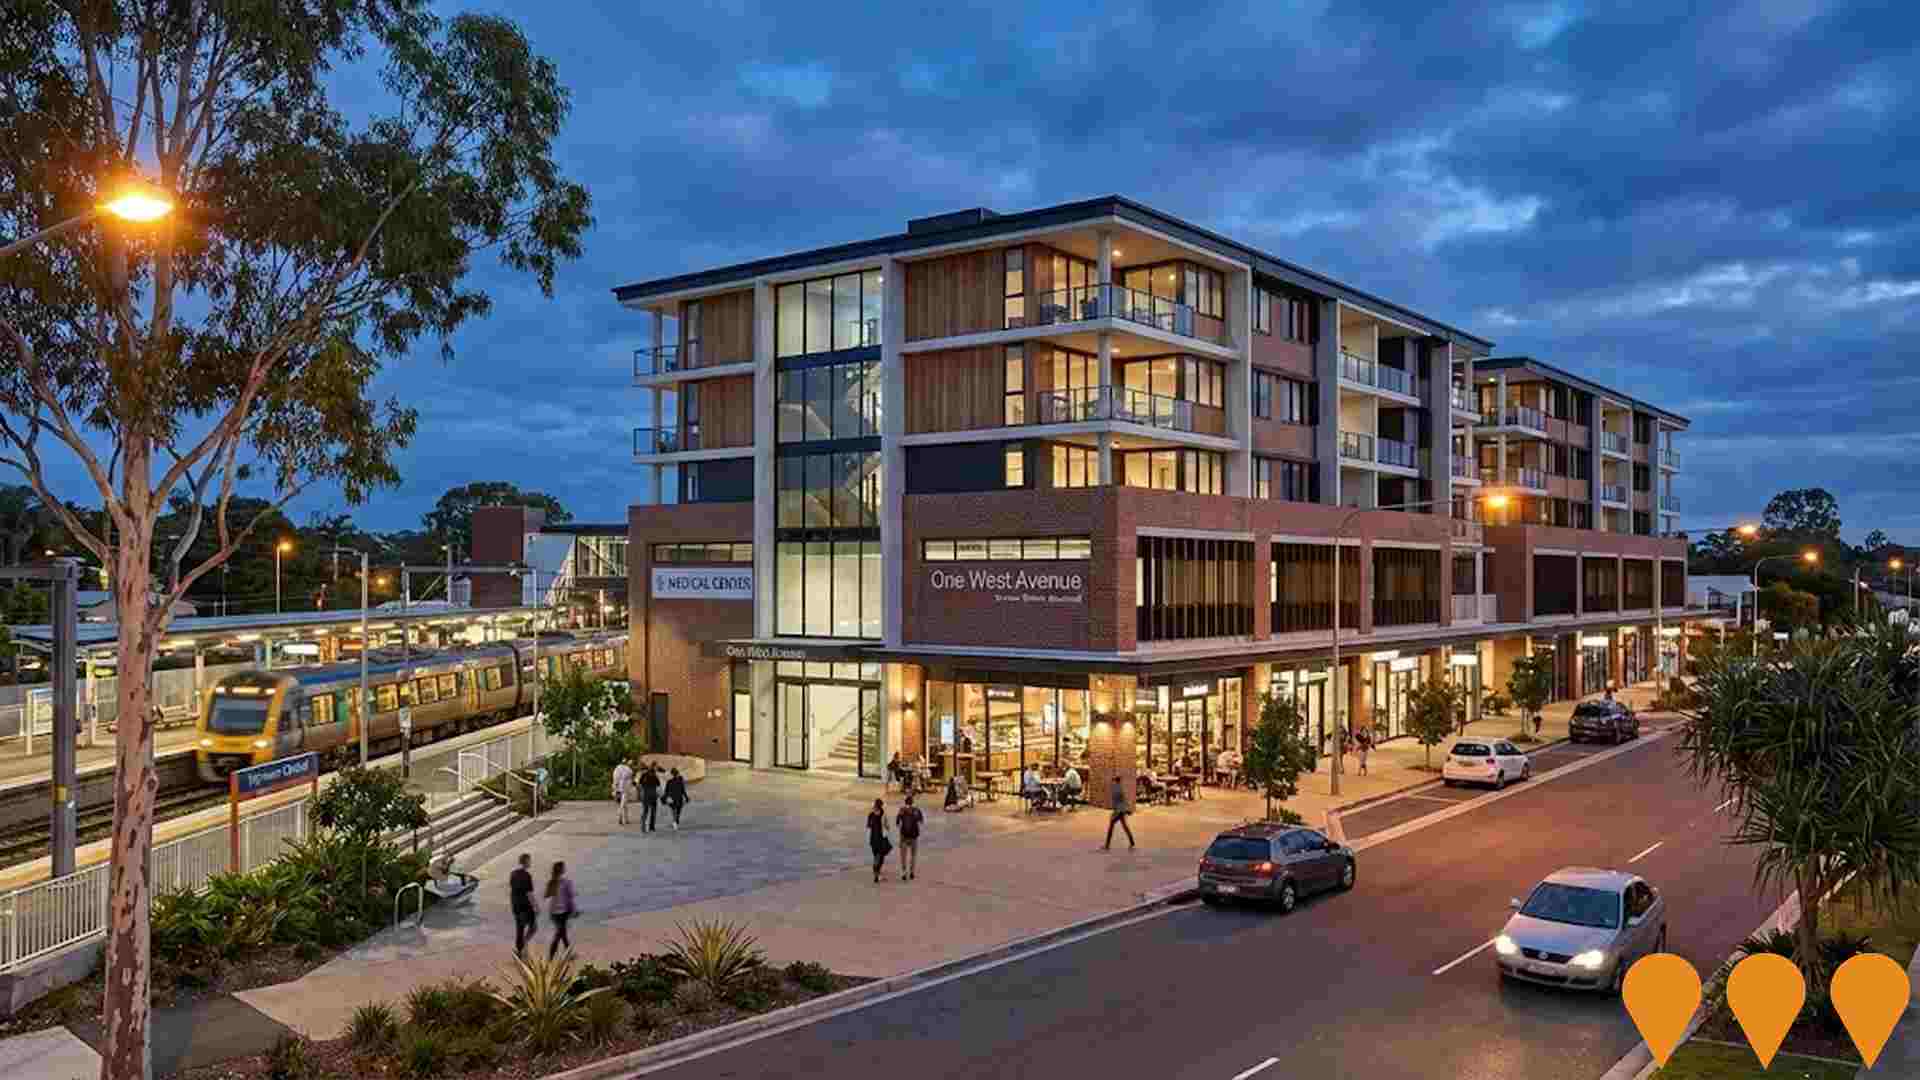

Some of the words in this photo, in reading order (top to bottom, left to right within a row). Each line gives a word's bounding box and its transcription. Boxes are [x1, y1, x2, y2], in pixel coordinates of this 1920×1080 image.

[931, 570, 965, 589] One
[968, 570, 1012, 589] West
[1015, 570, 1082, 589] Avenue
